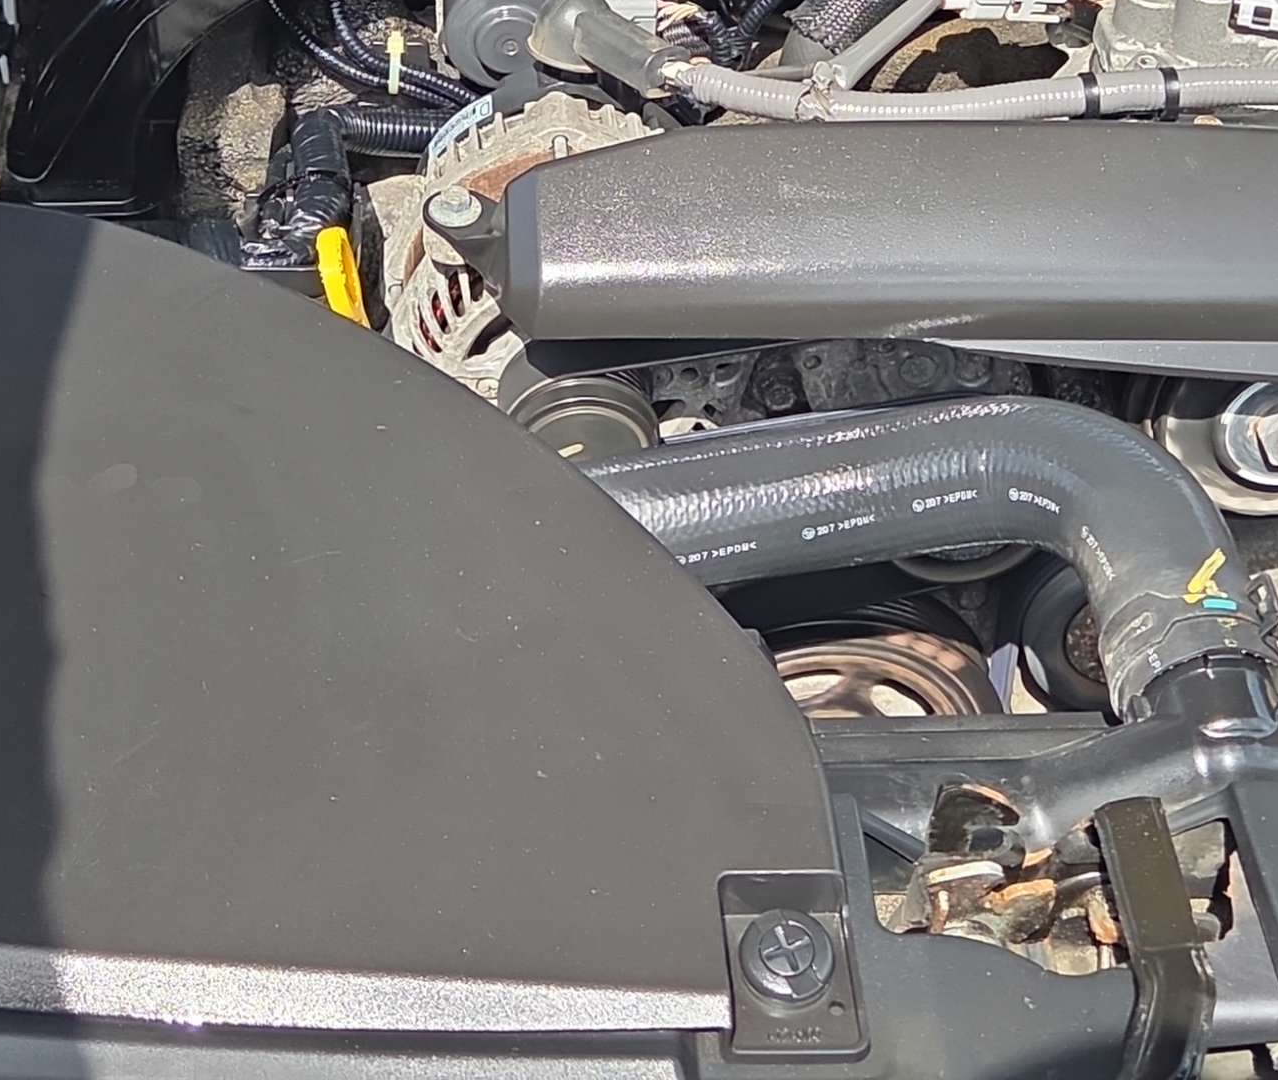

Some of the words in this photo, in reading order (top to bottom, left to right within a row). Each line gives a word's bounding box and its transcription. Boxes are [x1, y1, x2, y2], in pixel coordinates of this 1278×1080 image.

[924, 496, 942, 509] 207
[817, 523, 835, 537] 207
[838, 514, 876, 531] >EPDM<
[687, 550, 708, 564] 207
[712, 540, 757, 558] >EPDM<
